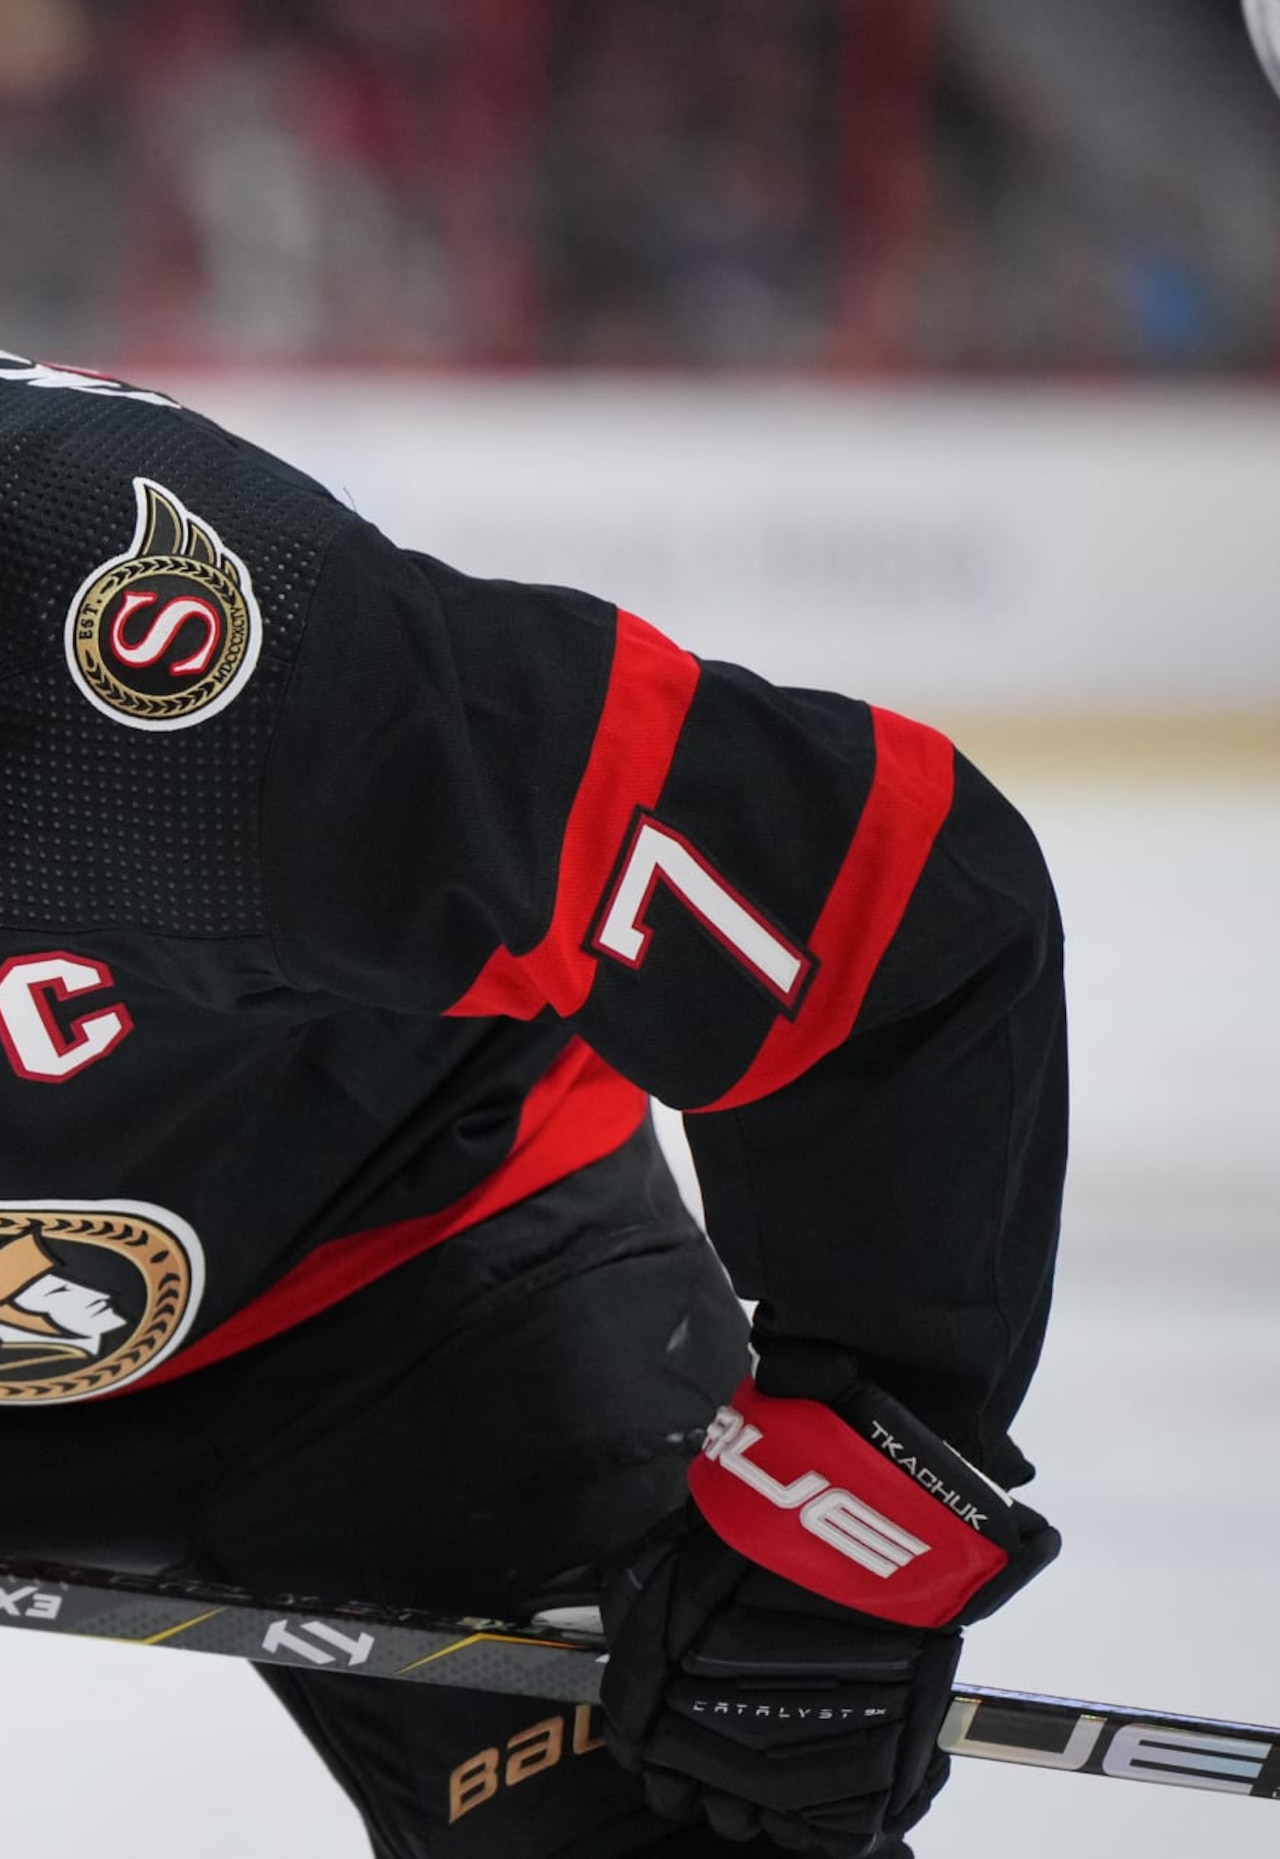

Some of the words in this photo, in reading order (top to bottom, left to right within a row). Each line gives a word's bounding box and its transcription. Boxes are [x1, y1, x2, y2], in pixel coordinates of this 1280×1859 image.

[110, 591, 221, 677] S
[589, 810, 813, 1009] 7
[700, 1404, 934, 1580] RUE
[871, 1419, 990, 1531] TKACHUK
[692, 1700, 854, 1720] CATALYST
[937, 1696, 1273, 1796] UE
